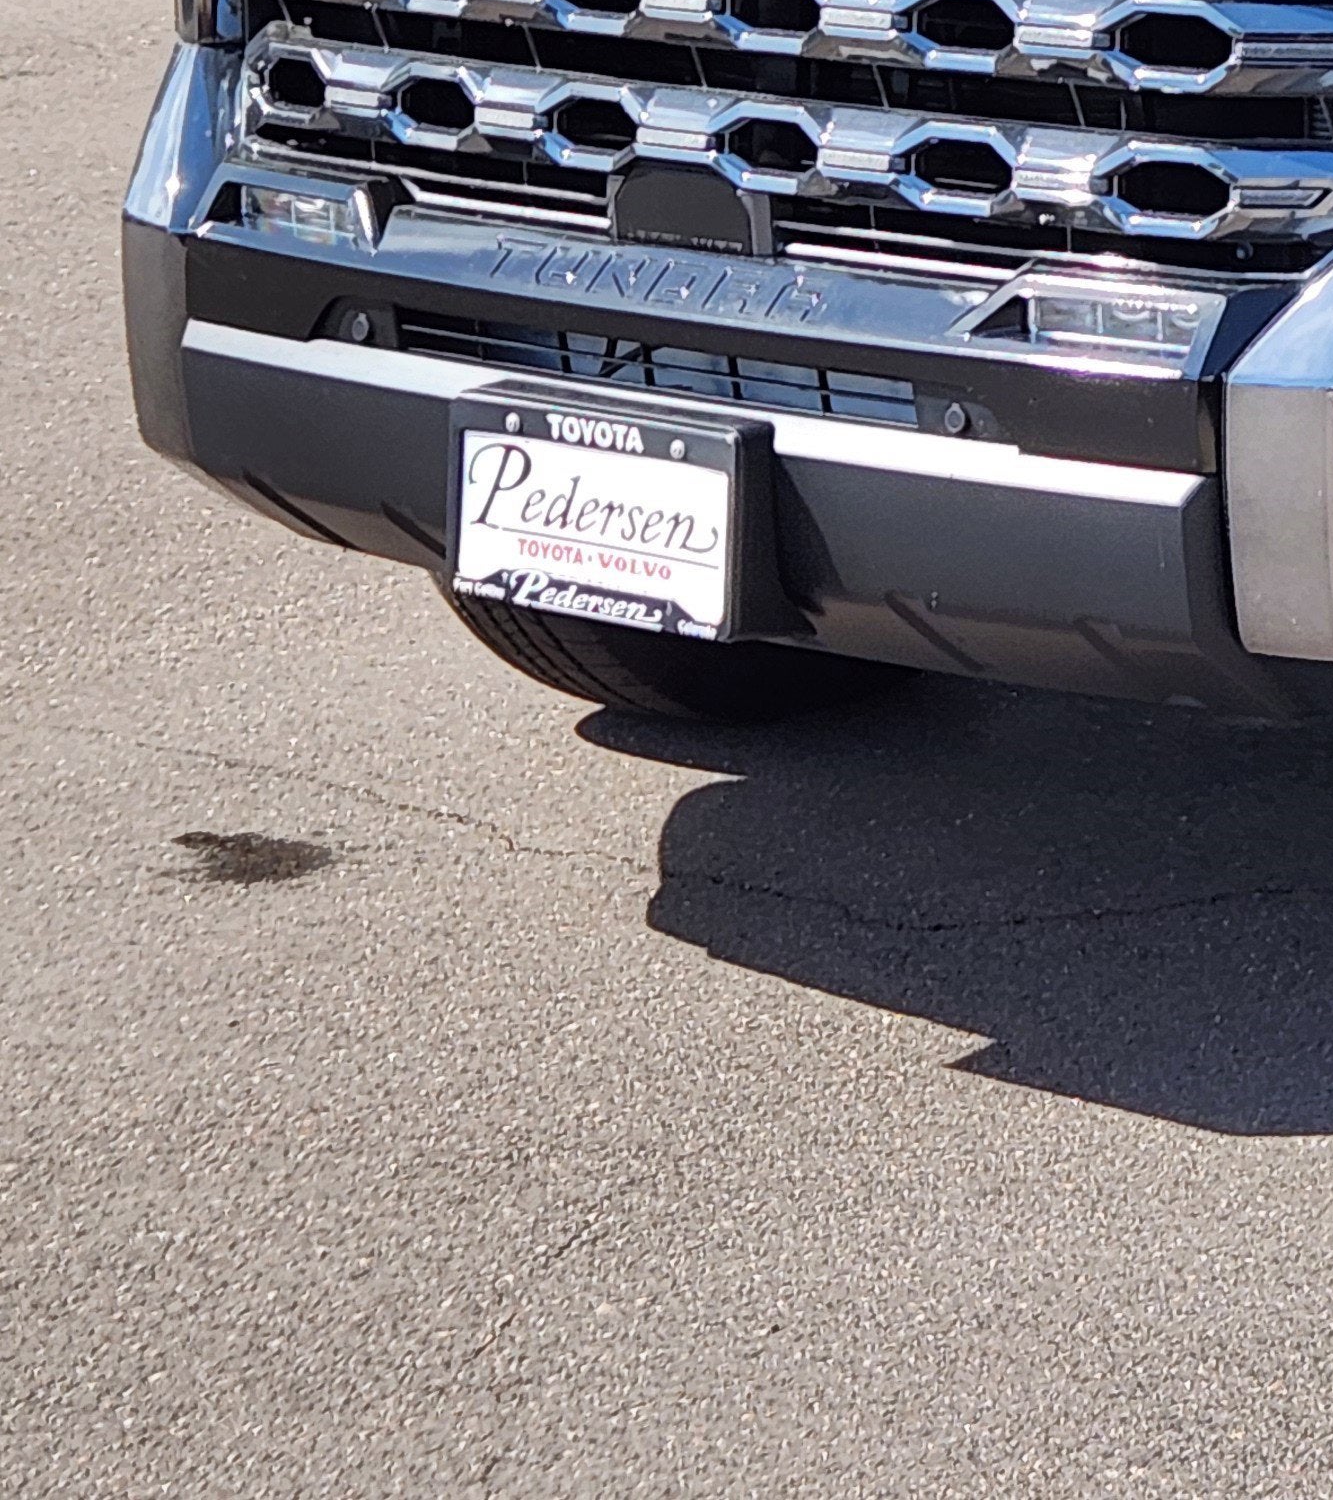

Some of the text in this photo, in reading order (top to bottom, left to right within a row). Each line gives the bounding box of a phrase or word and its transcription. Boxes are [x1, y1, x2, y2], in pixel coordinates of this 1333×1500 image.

[489, 233, 828, 323] TUNDRA
[545, 412, 645, 455] TOYOTA
[468, 442, 720, 553] Pedersen
[517, 537, 673, 581] TOYOTA VOLVO
[510, 568, 663, 627] Pedersen
